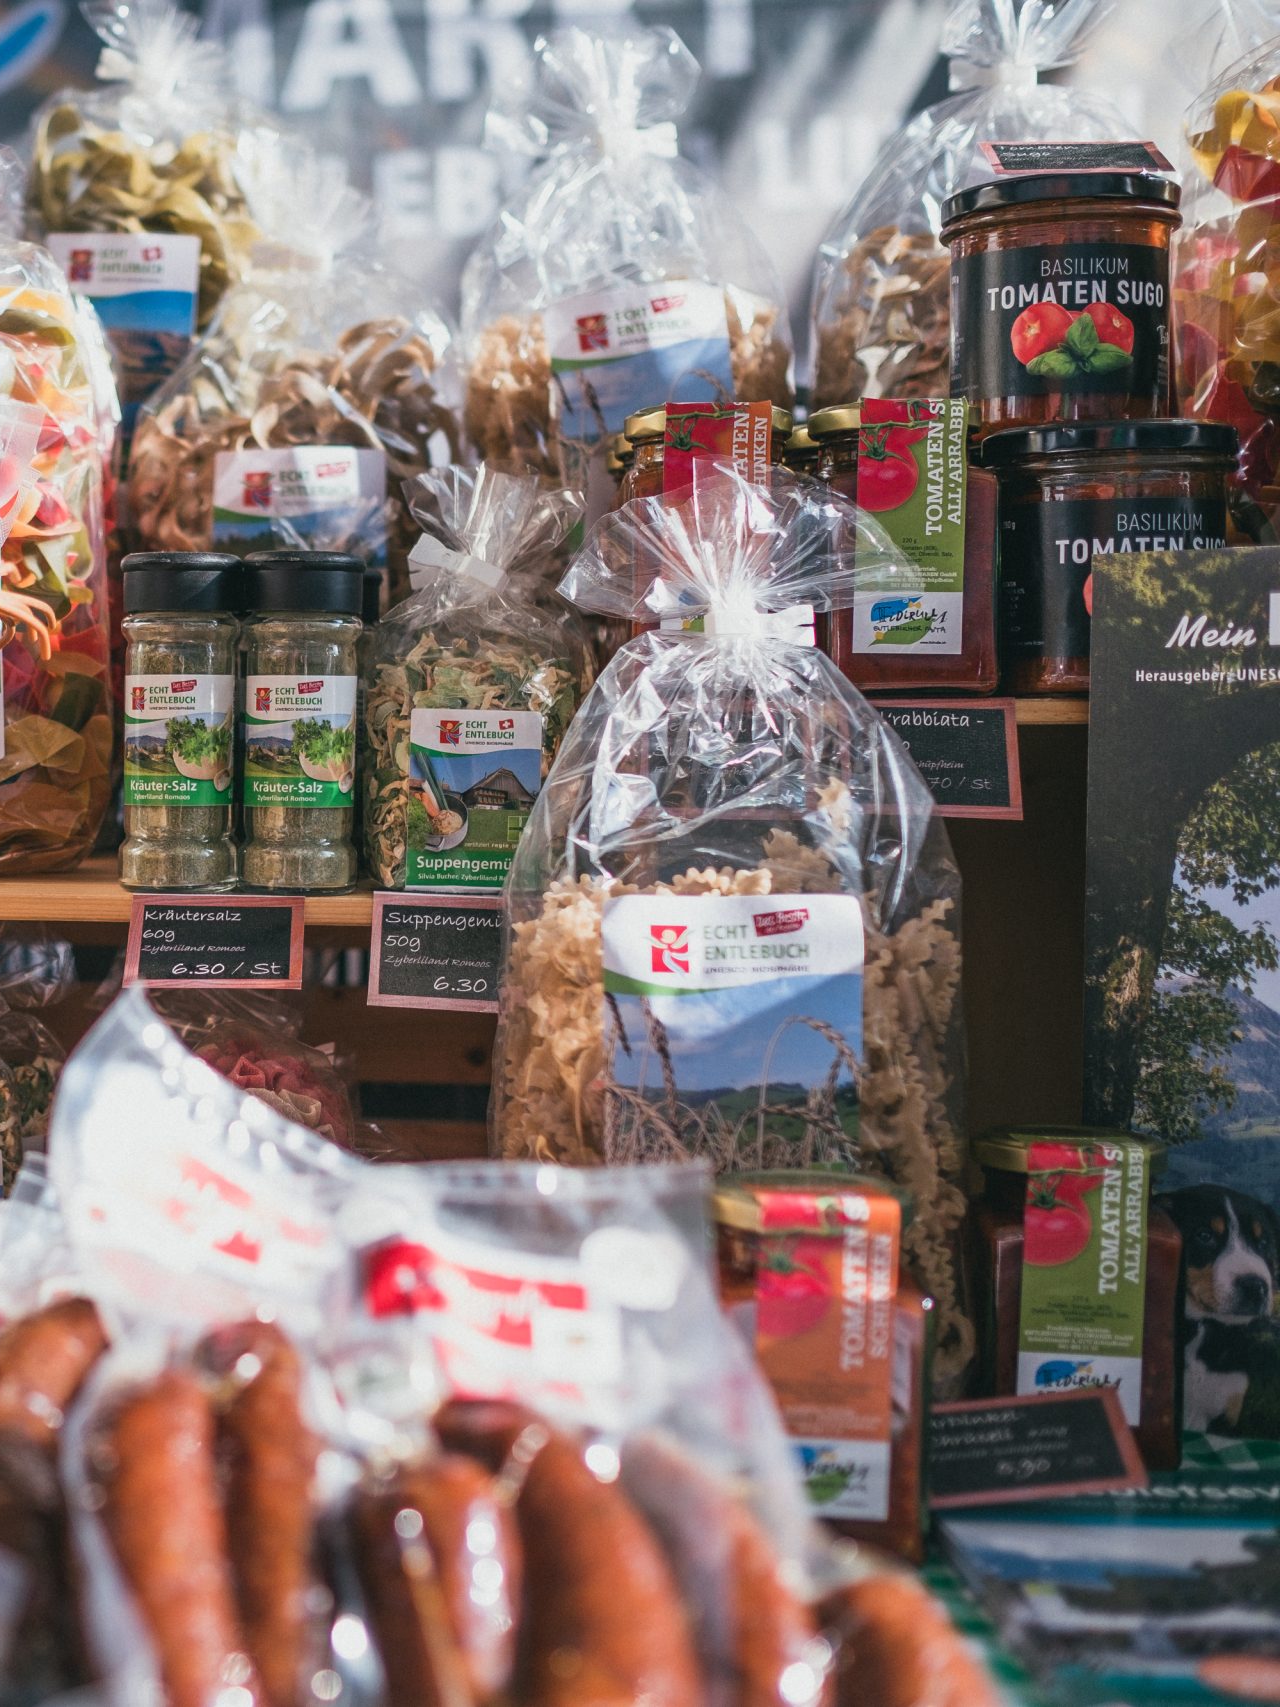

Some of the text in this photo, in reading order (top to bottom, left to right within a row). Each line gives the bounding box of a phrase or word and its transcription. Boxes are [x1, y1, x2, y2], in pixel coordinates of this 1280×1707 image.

[1041, 257, 1129, 276] BASILIKUM
[987, 280, 1163, 311] TOMATEN SUGO
[732, 411, 750, 480] ATEN
[753, 416, 768, 485] HINKEN
[925, 421, 946, 536] TOMATEN
[1116, 513, 1203, 532] BASILIKUM
[1165, 615, 1257, 648] Mein
[1237, 668, 1280, 681] UNES
[149, 686, 169, 694] ECHT
[149, 696, 196, 704] ENTLEBUCH
[465, 721, 487, 729] ECHT
[465, 731, 514, 739] ENTLEBUCH
[915, 760, 964, 771] chüpfheim
[130, 779, 197, 791] Kräuter-Salz
[253, 780, 323, 793] Kräuter-Salz
[971, 778, 992, 789] St
[417, 856, 513, 872] Suppengemü
[145, 910, 241, 921] Kräutersalz
[385, 912, 502, 931] Suppengem
[142, 929, 175, 942] 60g
[703, 925, 748, 940] ECHT
[141, 944, 205, 954] Zyberliland
[385, 936, 420, 952] 50g
[705, 943, 810, 961] ENTLEBUCH
[171, 962, 281, 975] 6.30 / St
[384, 955, 491, 968] Zyberliland Romoos
[433, 976, 488, 993] 6.30
[1098, 1168, 1123, 1295] TOMATEN
[839, 1226, 868, 1371] TOMATEN
